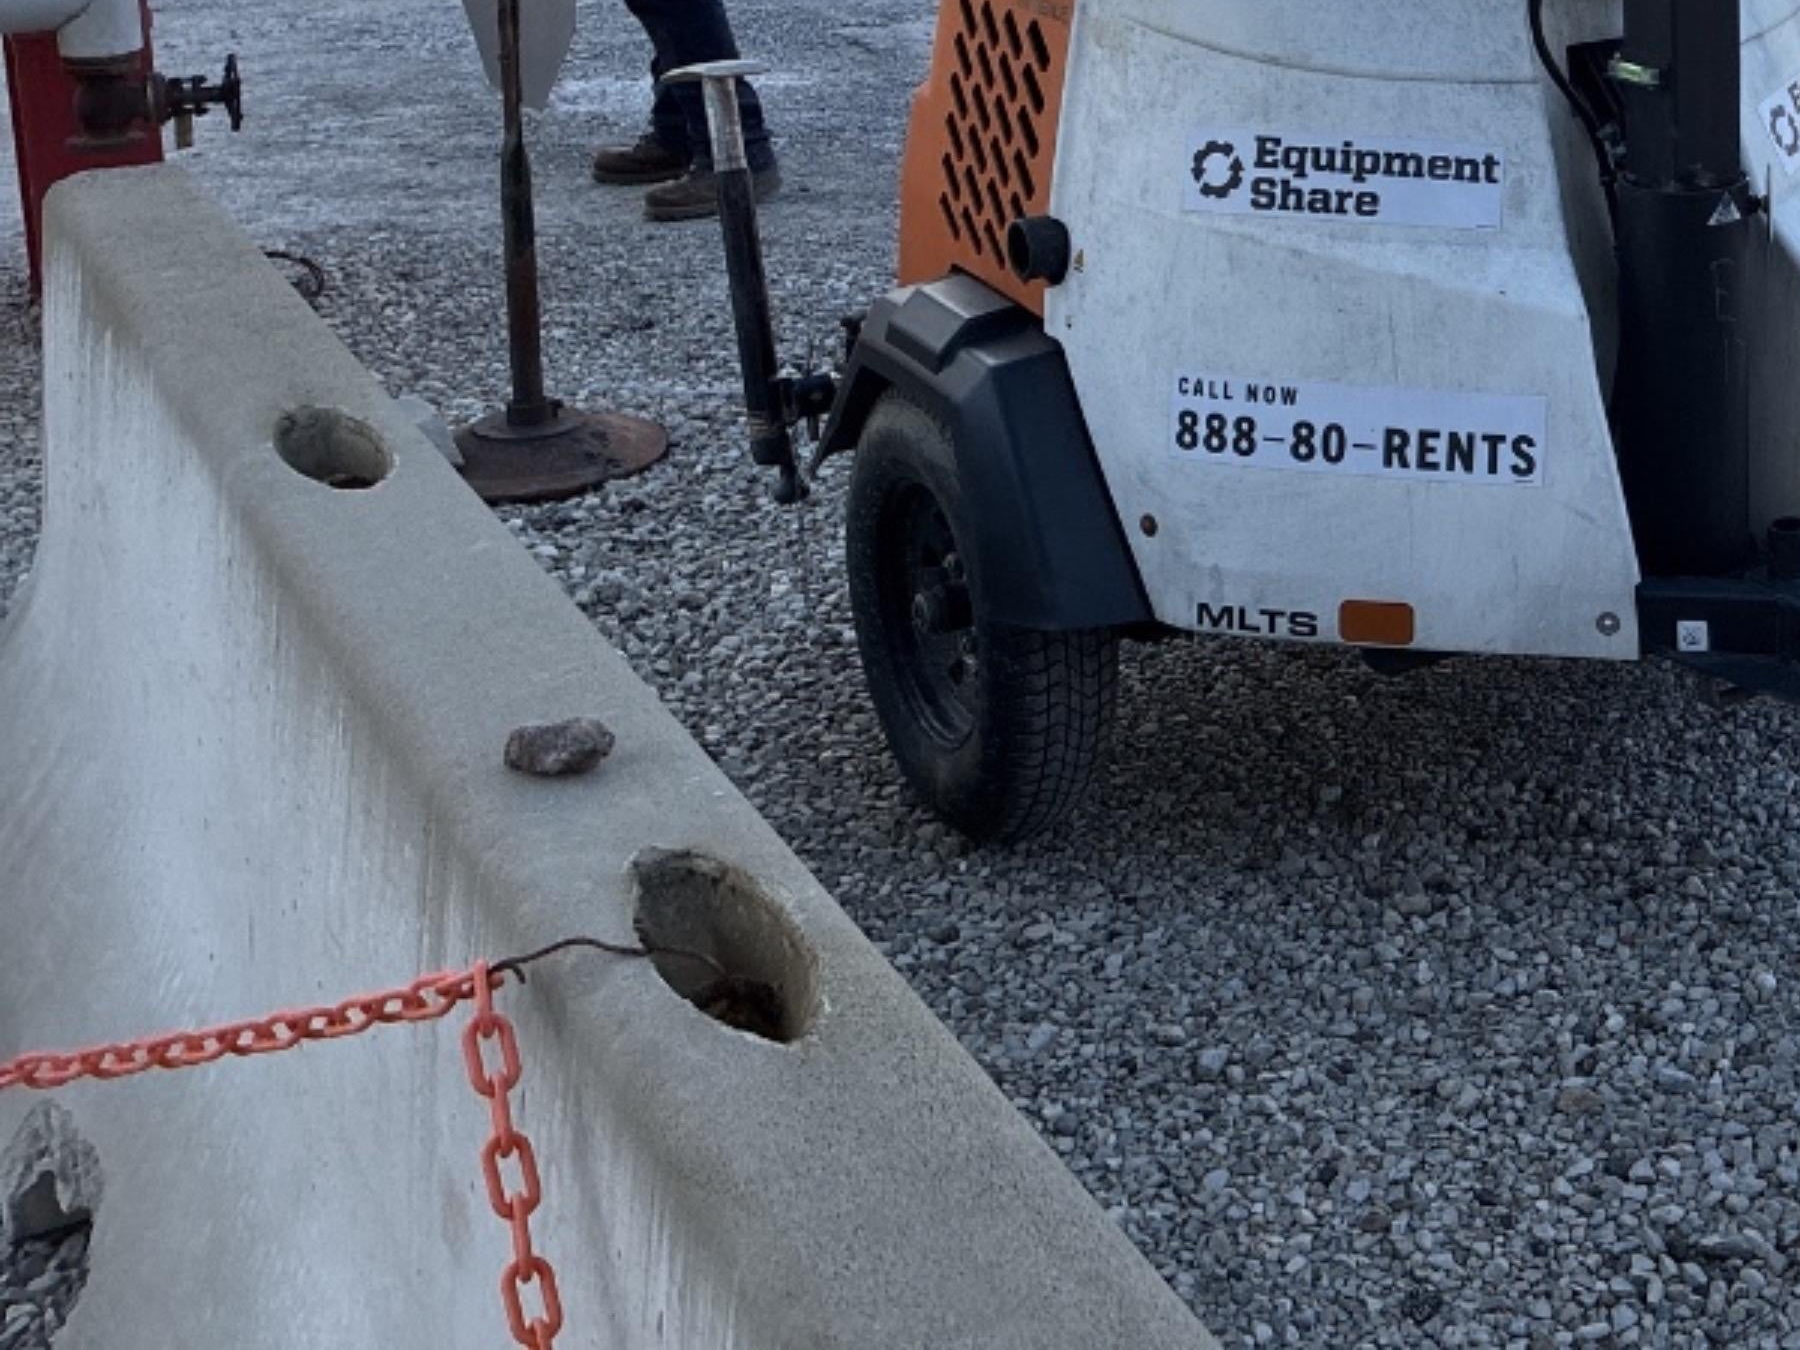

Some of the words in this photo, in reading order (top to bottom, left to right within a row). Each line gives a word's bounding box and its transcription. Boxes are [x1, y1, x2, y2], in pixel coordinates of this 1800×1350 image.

[1253, 135, 1500, 183] Equipment
[1249, 178, 1380, 217] Share
[1178, 377, 1234, 401] CALL
[1246, 383, 1298, 406] NOW
[1175, 409, 1537, 478] 888-80-RENTS
[1196, 602, 1318, 637] MLTS
